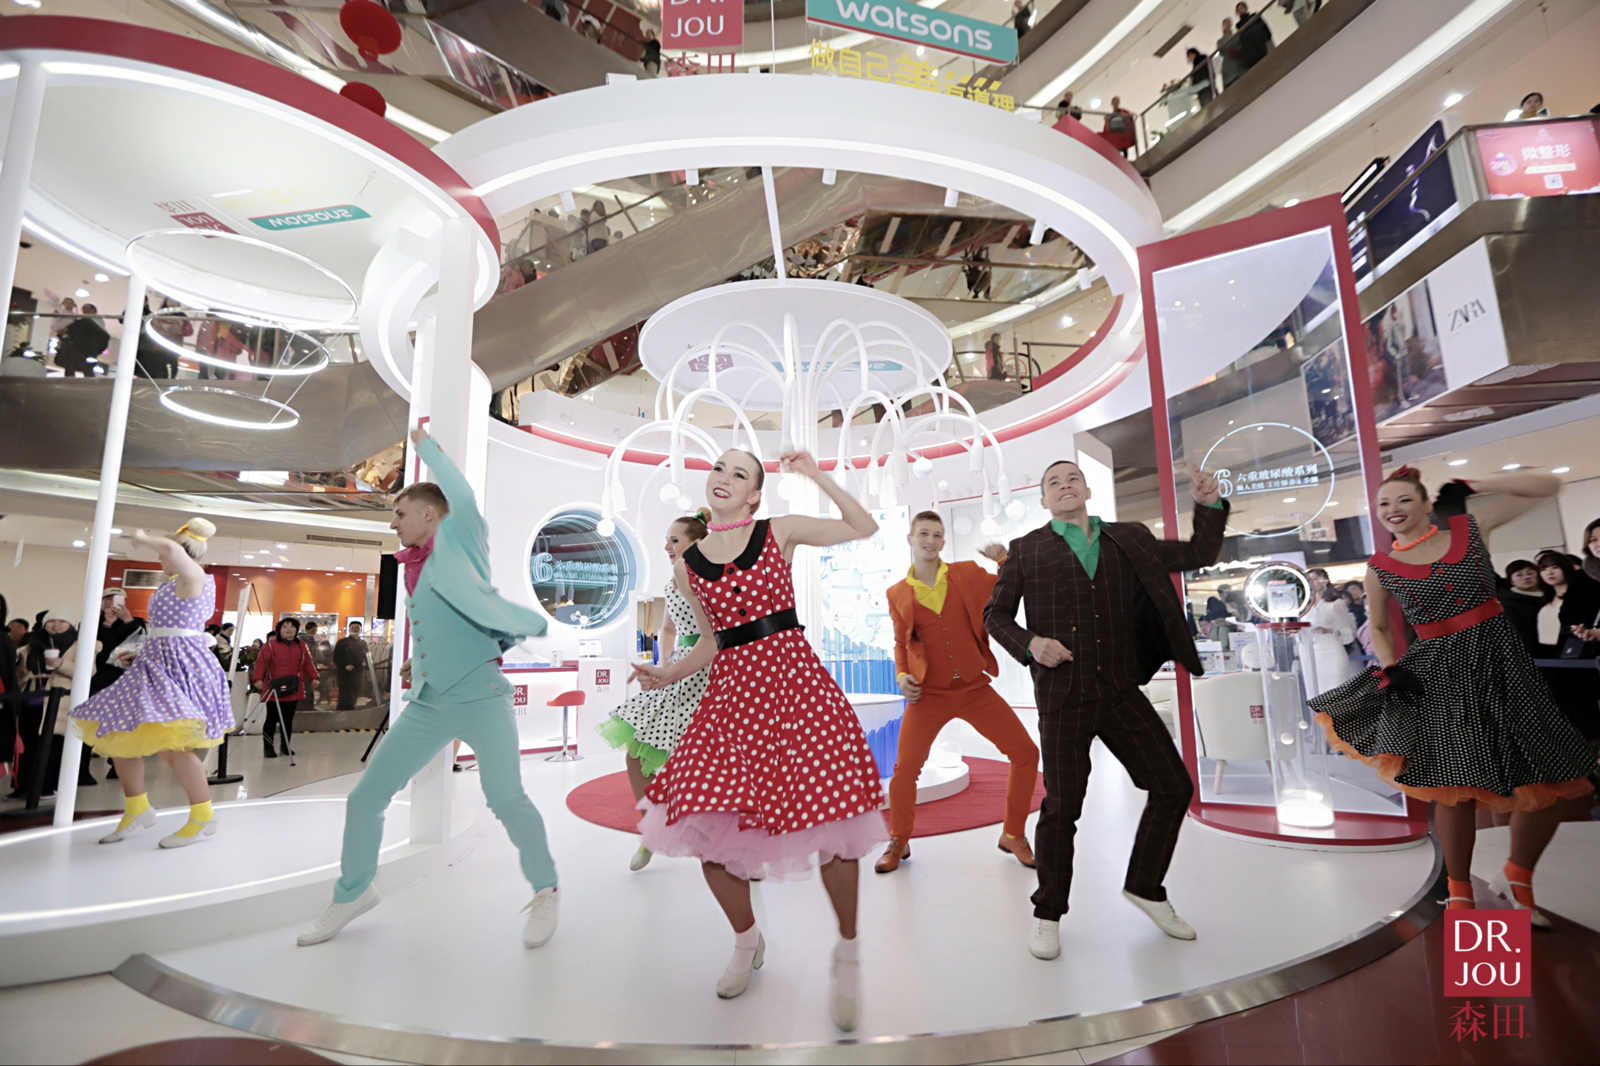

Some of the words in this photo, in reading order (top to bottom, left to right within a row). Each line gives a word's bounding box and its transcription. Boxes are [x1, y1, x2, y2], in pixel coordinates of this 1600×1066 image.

[670, 14, 724, 38] JOU
[836, 0, 992, 51] watsons
[1447, 298, 1487, 333] ZARA
[1213, 468, 1234, 498] 6
[1236, 463, 1318, 483] 六重玻尿酸系列
